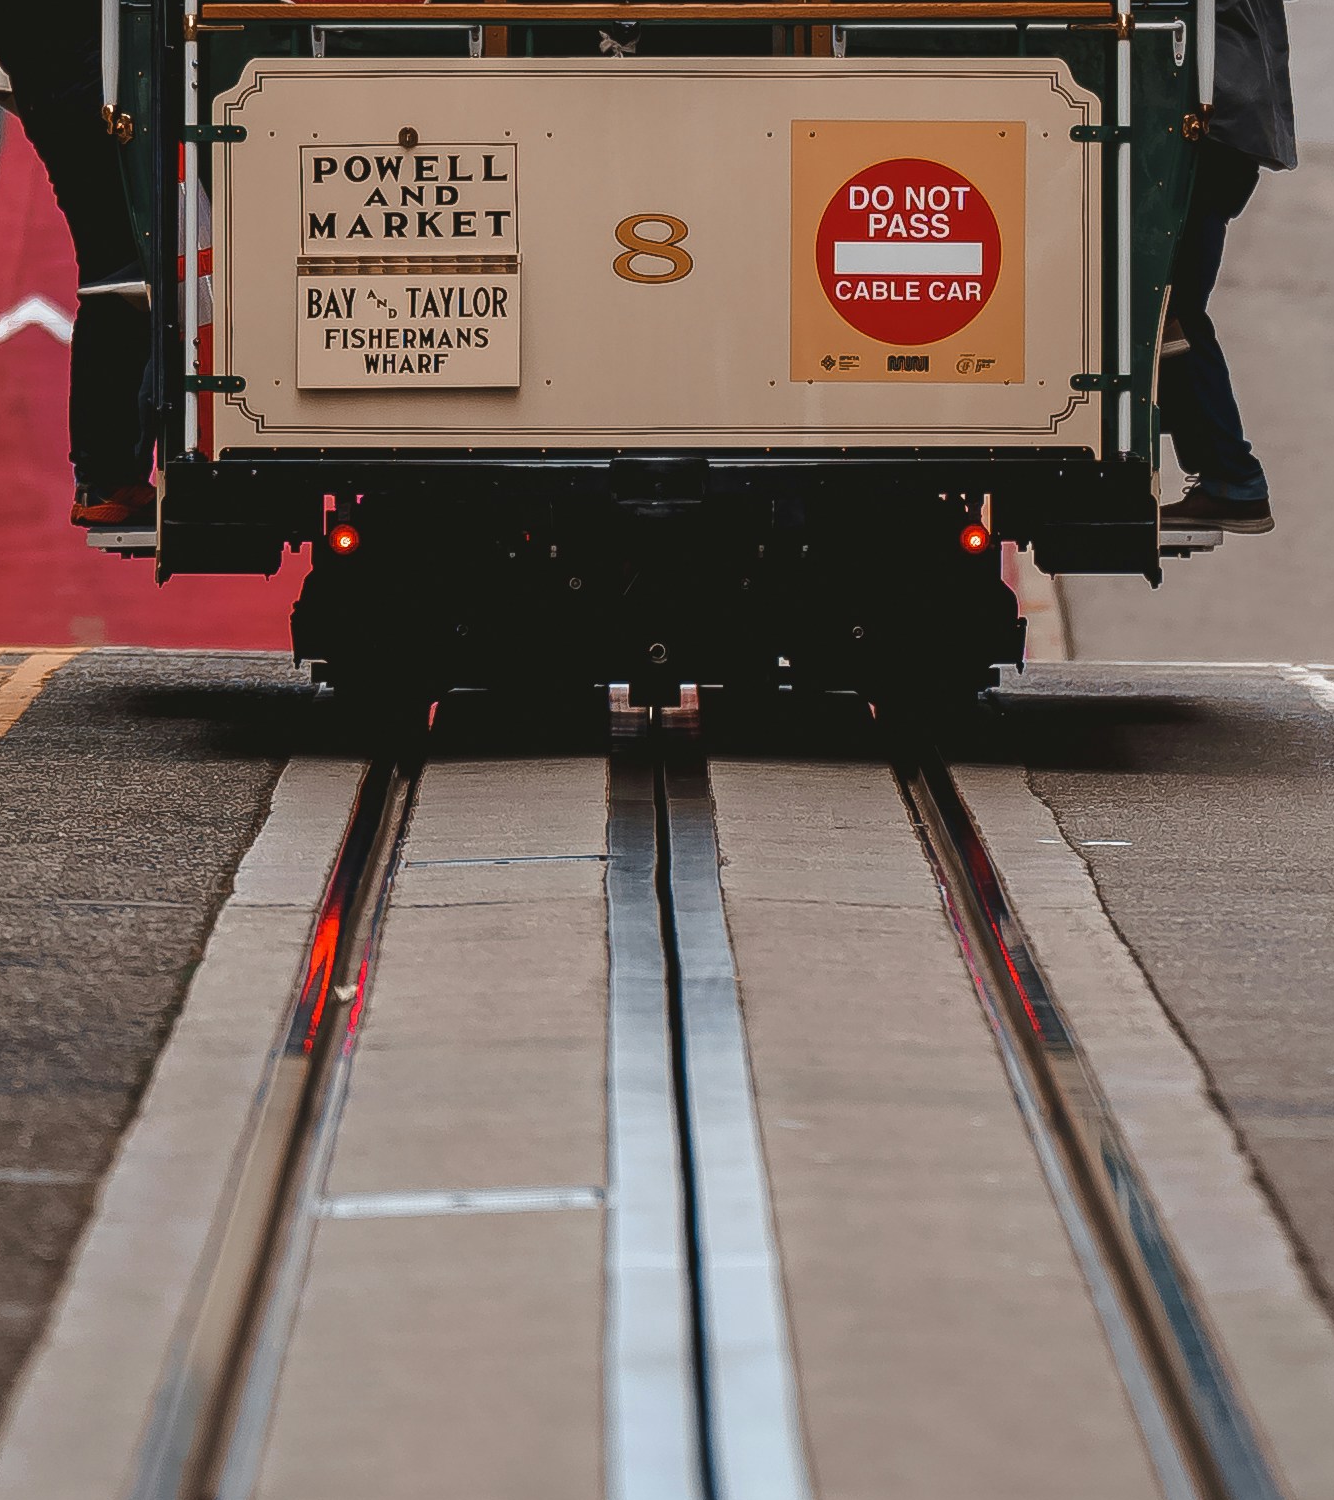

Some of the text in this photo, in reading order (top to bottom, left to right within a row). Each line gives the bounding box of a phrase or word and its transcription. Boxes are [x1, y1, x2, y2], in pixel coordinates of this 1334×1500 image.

[312, 154, 508, 184] POWELL
[364, 185, 459, 207] AND
[849, 185, 971, 211] DO NOT
[308, 211, 511, 239] MARKET
[868, 213, 951, 239] PASS
[613, 213, 694, 285] 8
[306, 286, 508, 319] BAY AND TAYLOR
[835, 280, 982, 301] CABLE CAR
[324, 327, 490, 350] FISHERMANS
[364, 353, 449, 375] WHARF
